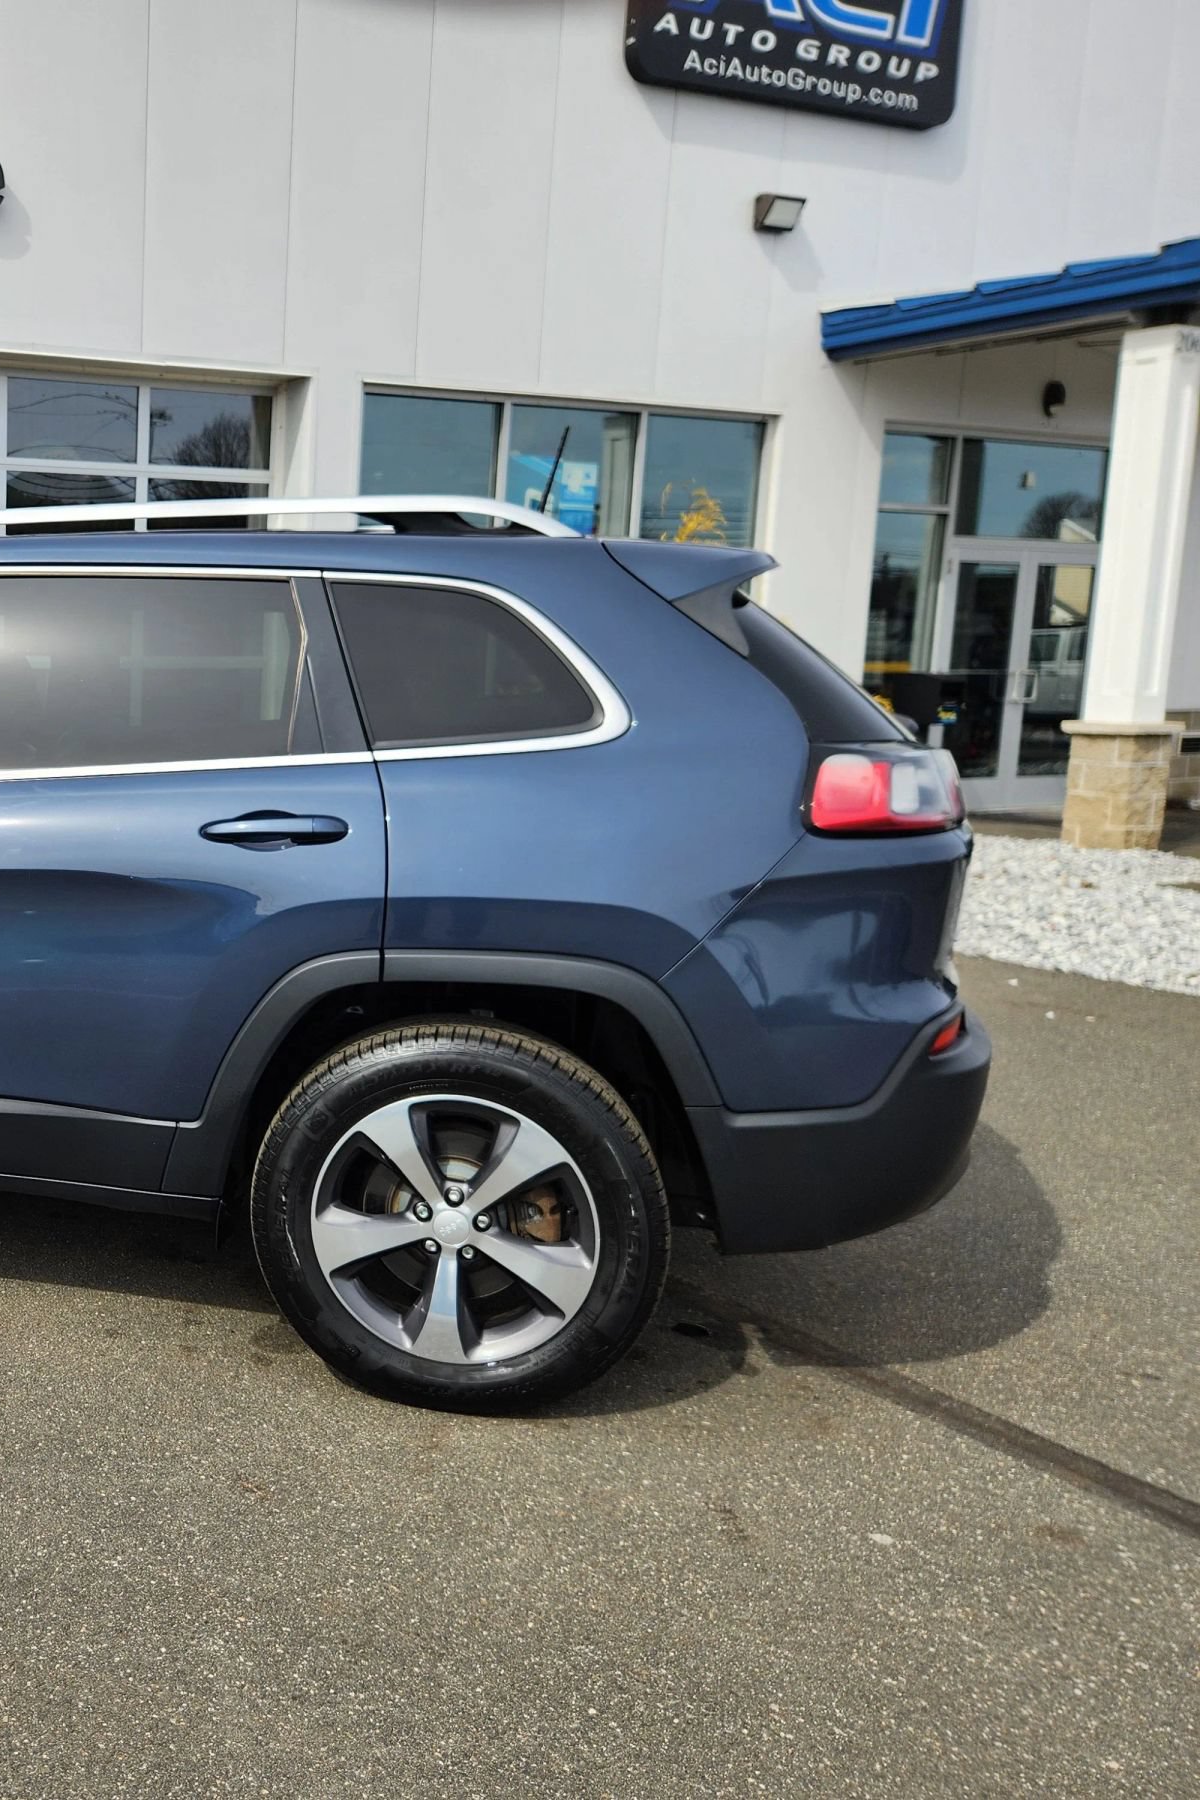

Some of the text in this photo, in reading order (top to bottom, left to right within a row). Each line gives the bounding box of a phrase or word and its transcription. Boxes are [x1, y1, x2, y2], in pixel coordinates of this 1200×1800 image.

[653, 12, 777, 52] AUTO
[796, 38, 939, 83] GROUP
[683, 50, 919, 112] AciAutoGroup.com
